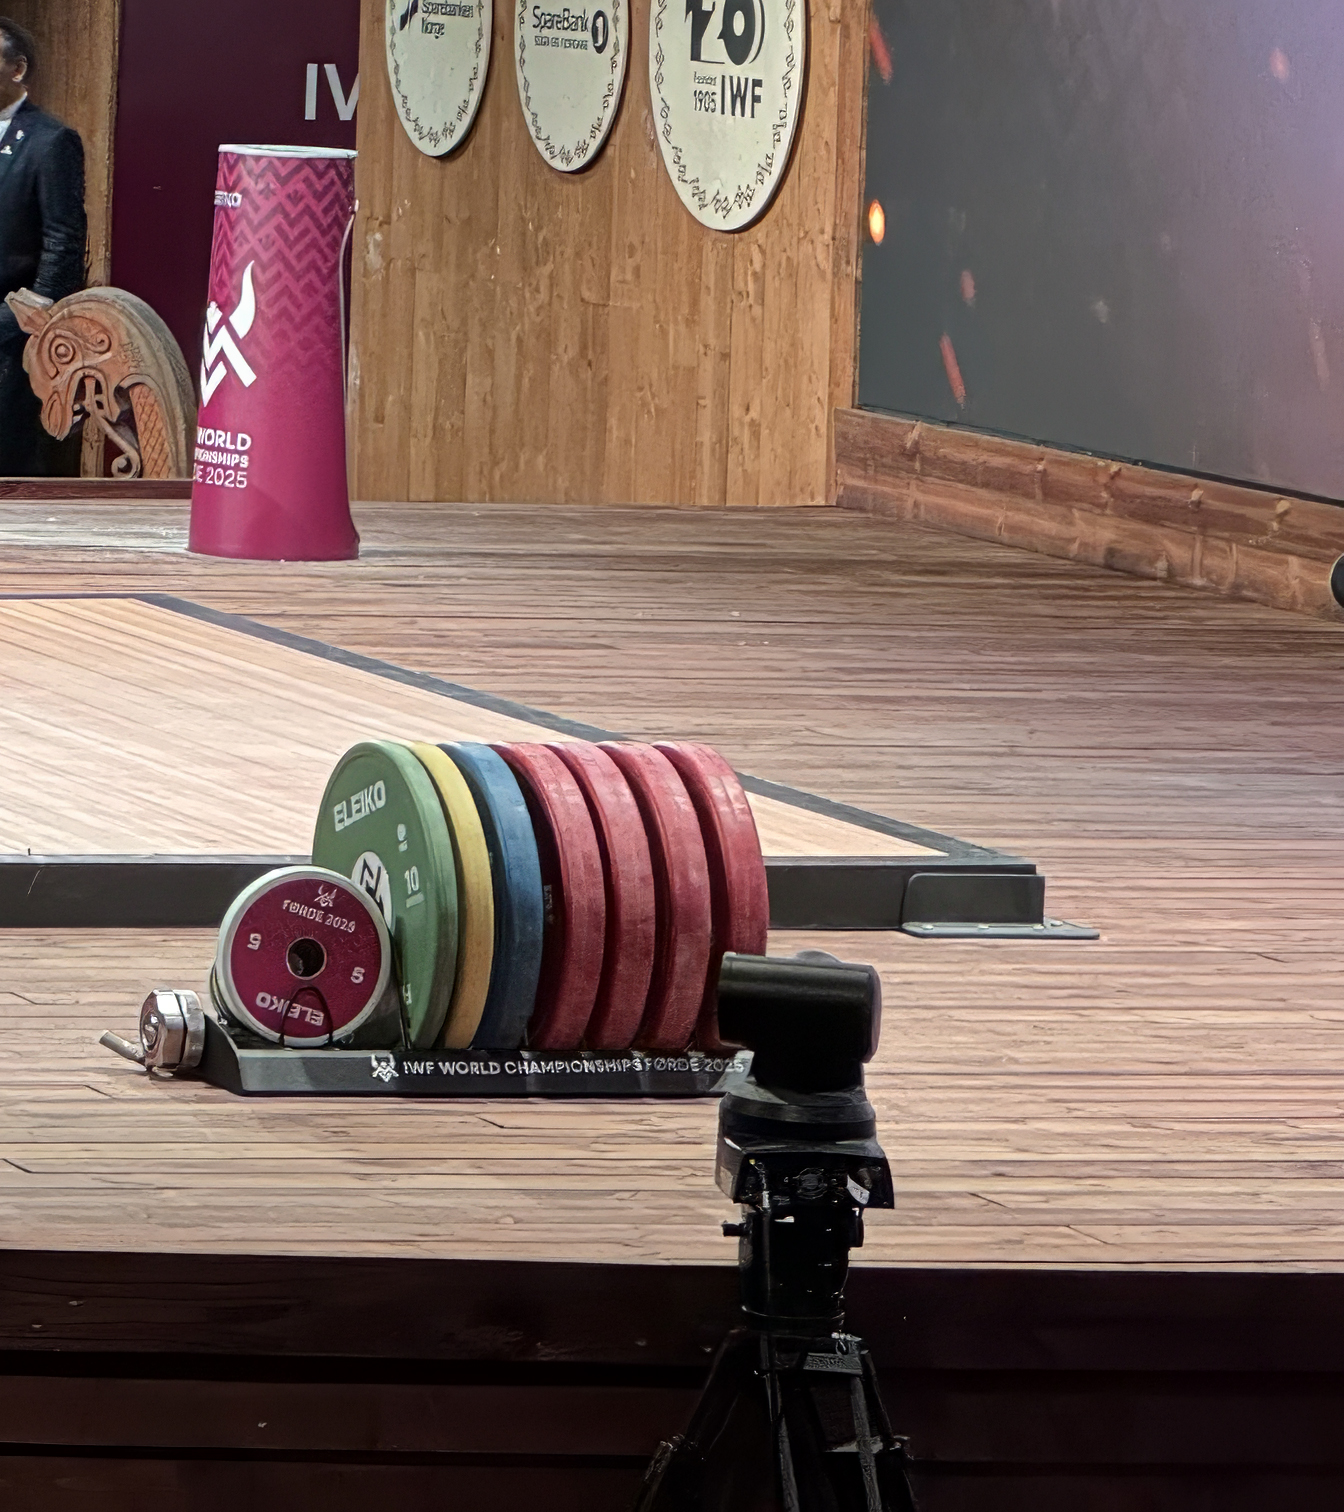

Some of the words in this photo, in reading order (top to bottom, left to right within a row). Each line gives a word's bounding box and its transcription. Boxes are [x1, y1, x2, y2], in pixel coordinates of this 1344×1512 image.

[533, 5, 589, 33] SpareBank
[693, 89, 717, 113] 1905
[720, 74, 763, 118] IWF
[205, 466, 248, 489] 2025
[334, 780, 386, 832] ELEIKO
[404, 865, 419, 895] 10
[350, 966, 365, 984] 5
[256, 992, 324, 1026] ELEIKO
[404, 1061, 434, 1074] IWF
[440, 1061, 500, 1075] WORLD
[505, 1058, 642, 1075] CHAMPIONSHIPS
